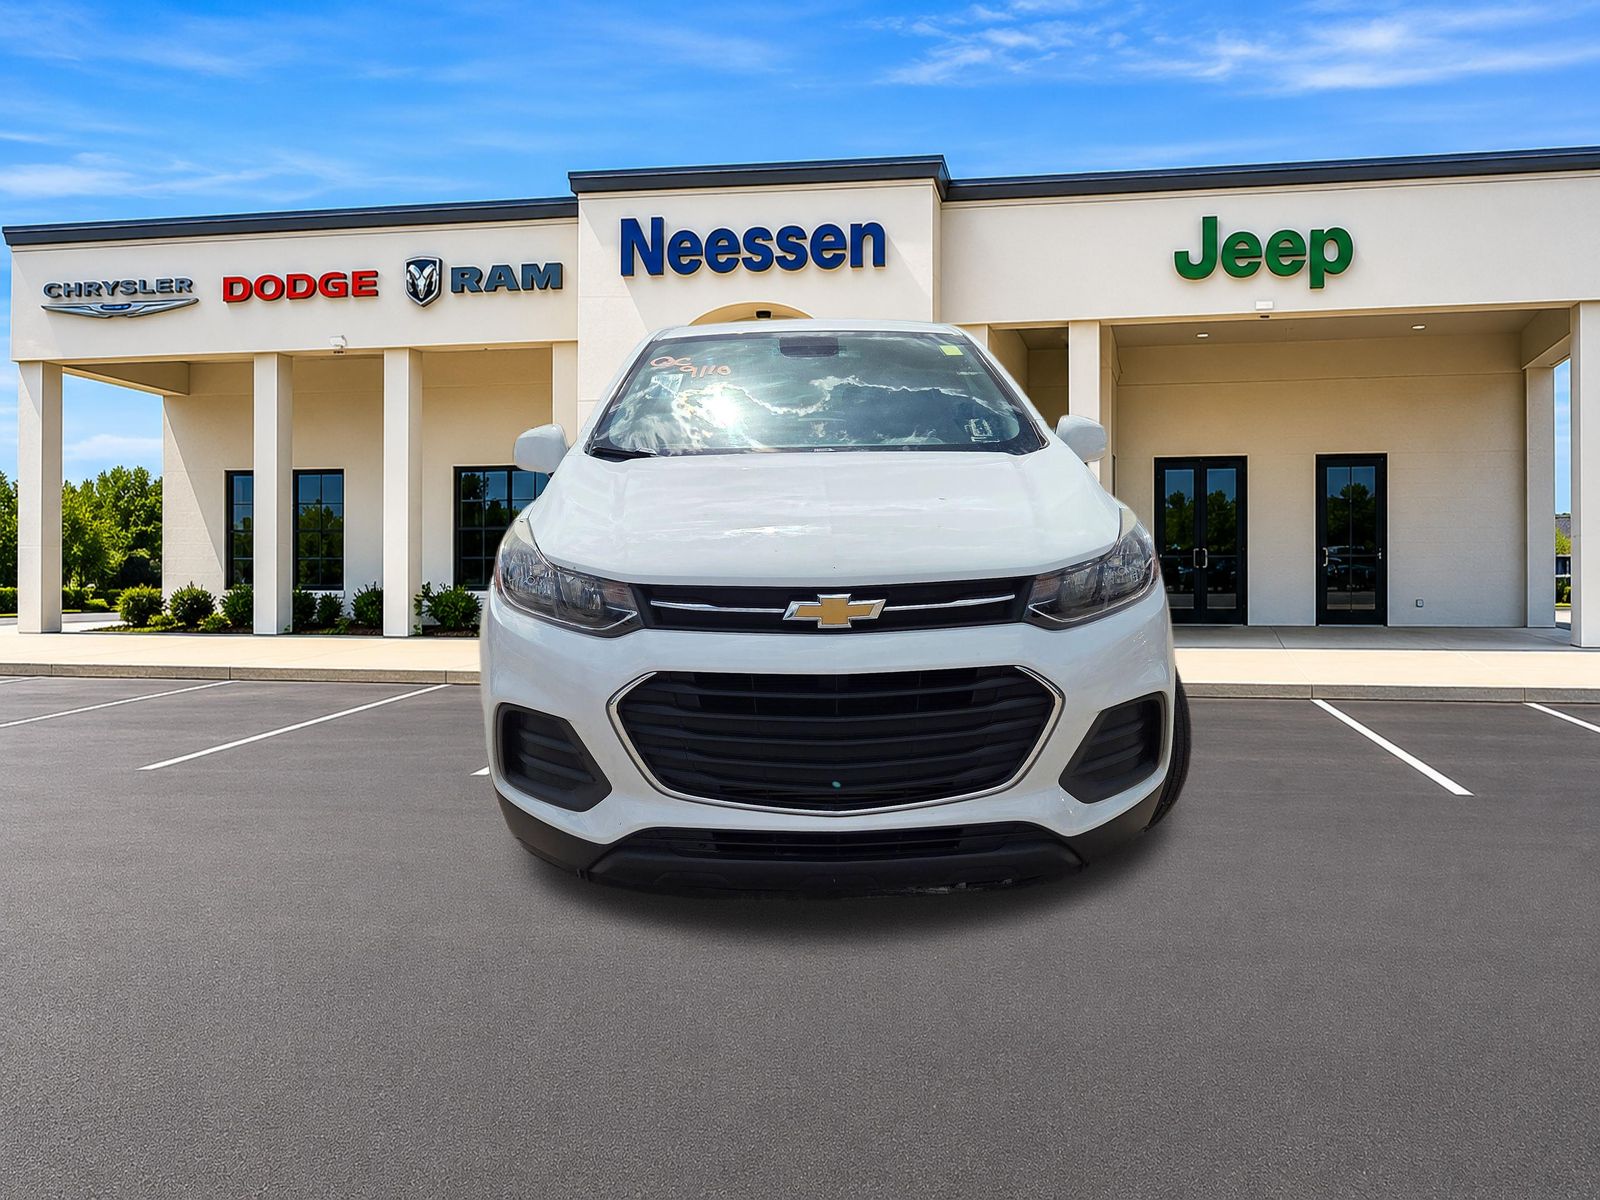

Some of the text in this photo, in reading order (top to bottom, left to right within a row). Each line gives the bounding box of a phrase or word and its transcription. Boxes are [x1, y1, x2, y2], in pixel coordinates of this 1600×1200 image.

[620, 216, 886, 276] Neessen
[1174, 215, 1354, 289] Jeep
[43, 277, 194, 298] CHRYSLER
[222, 270, 379, 303] DODGE
[450, 262, 564, 294] RAM
